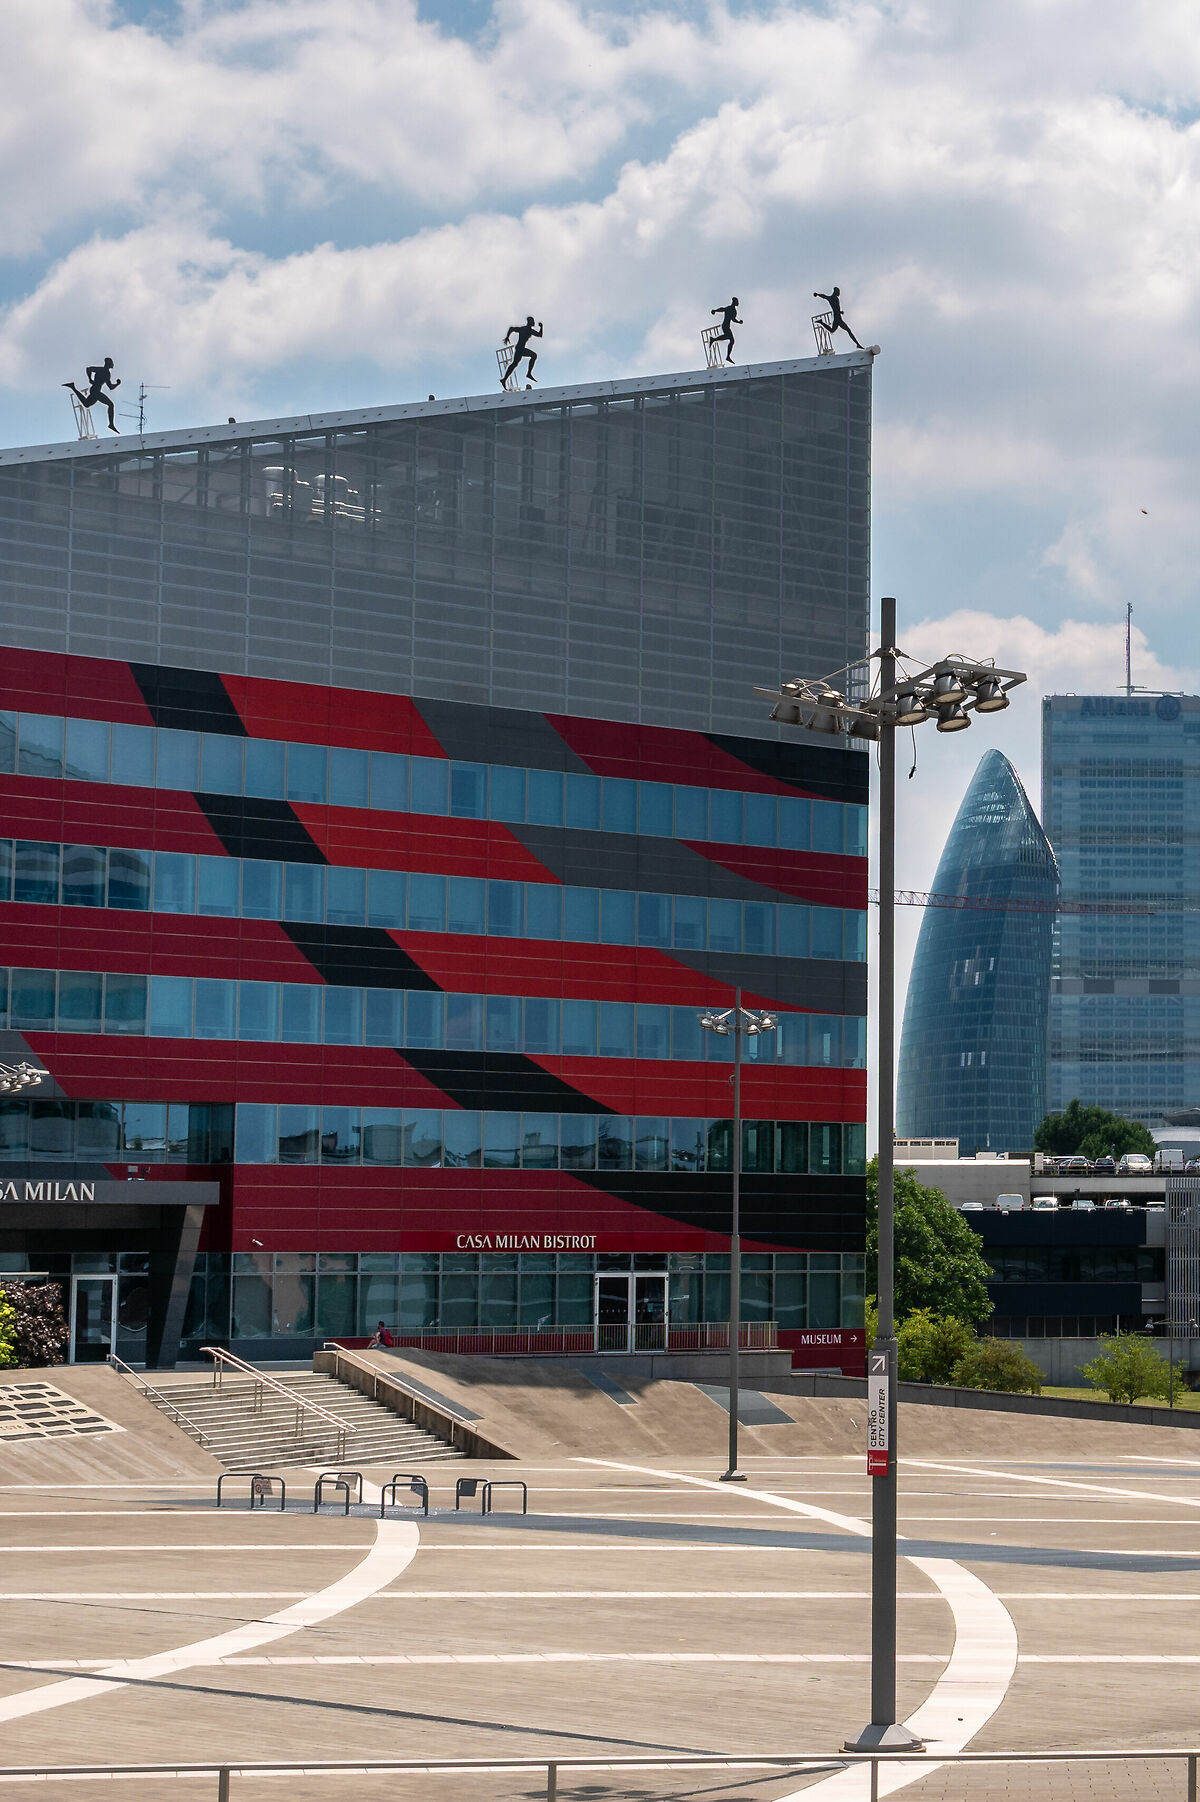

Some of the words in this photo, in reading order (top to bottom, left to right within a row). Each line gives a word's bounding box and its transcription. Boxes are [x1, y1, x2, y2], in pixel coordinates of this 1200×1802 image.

[1081, 698, 1150, 716] Allianz
[25, 1182, 95, 1201] MILAN
[456, 1234, 492, 1249] CASA
[495, 1235, 540, 1249] MILAN
[543, 1235, 597, 1249] BISTROT
[801, 1334, 842, 1345] MUSEUM
